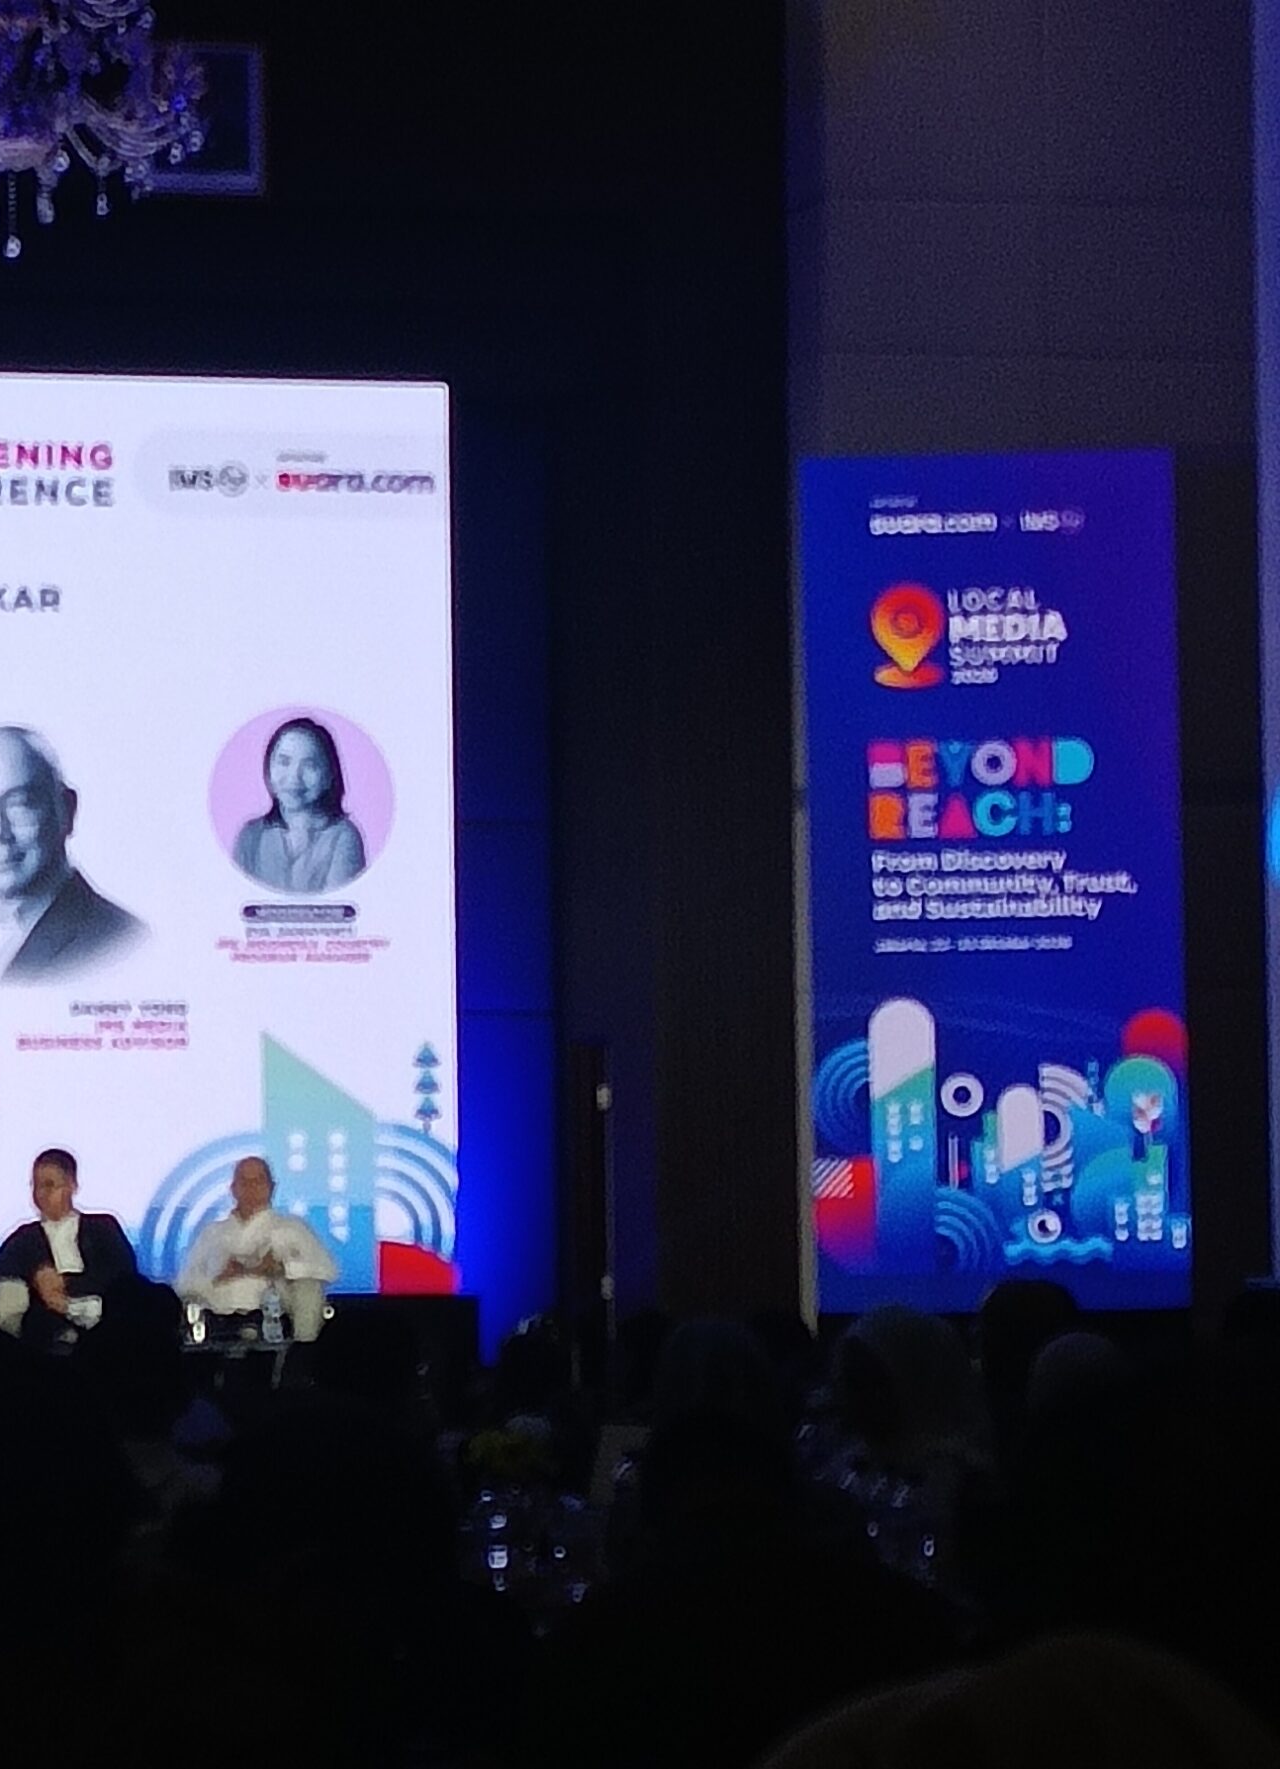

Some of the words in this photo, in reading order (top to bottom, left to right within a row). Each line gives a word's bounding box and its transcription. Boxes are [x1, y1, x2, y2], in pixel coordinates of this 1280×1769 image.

[948, 586, 1040, 613] LOCAL
[949, 609, 1069, 643] MEDIA
[949, 642, 1060, 667] SUMMIT
[867, 737, 1095, 789] BEYOND
[867, 789, 1072, 841] REACH:
[871, 850, 939, 873] From
[940, 849, 1067, 873] Discovery
[872, 875, 904, 897] to
[906, 873, 1060, 898] Community,
[1062, 870, 1138, 894] Trust,
[873, 899, 923, 921] and
[924, 896, 1103, 921] Sustainability
